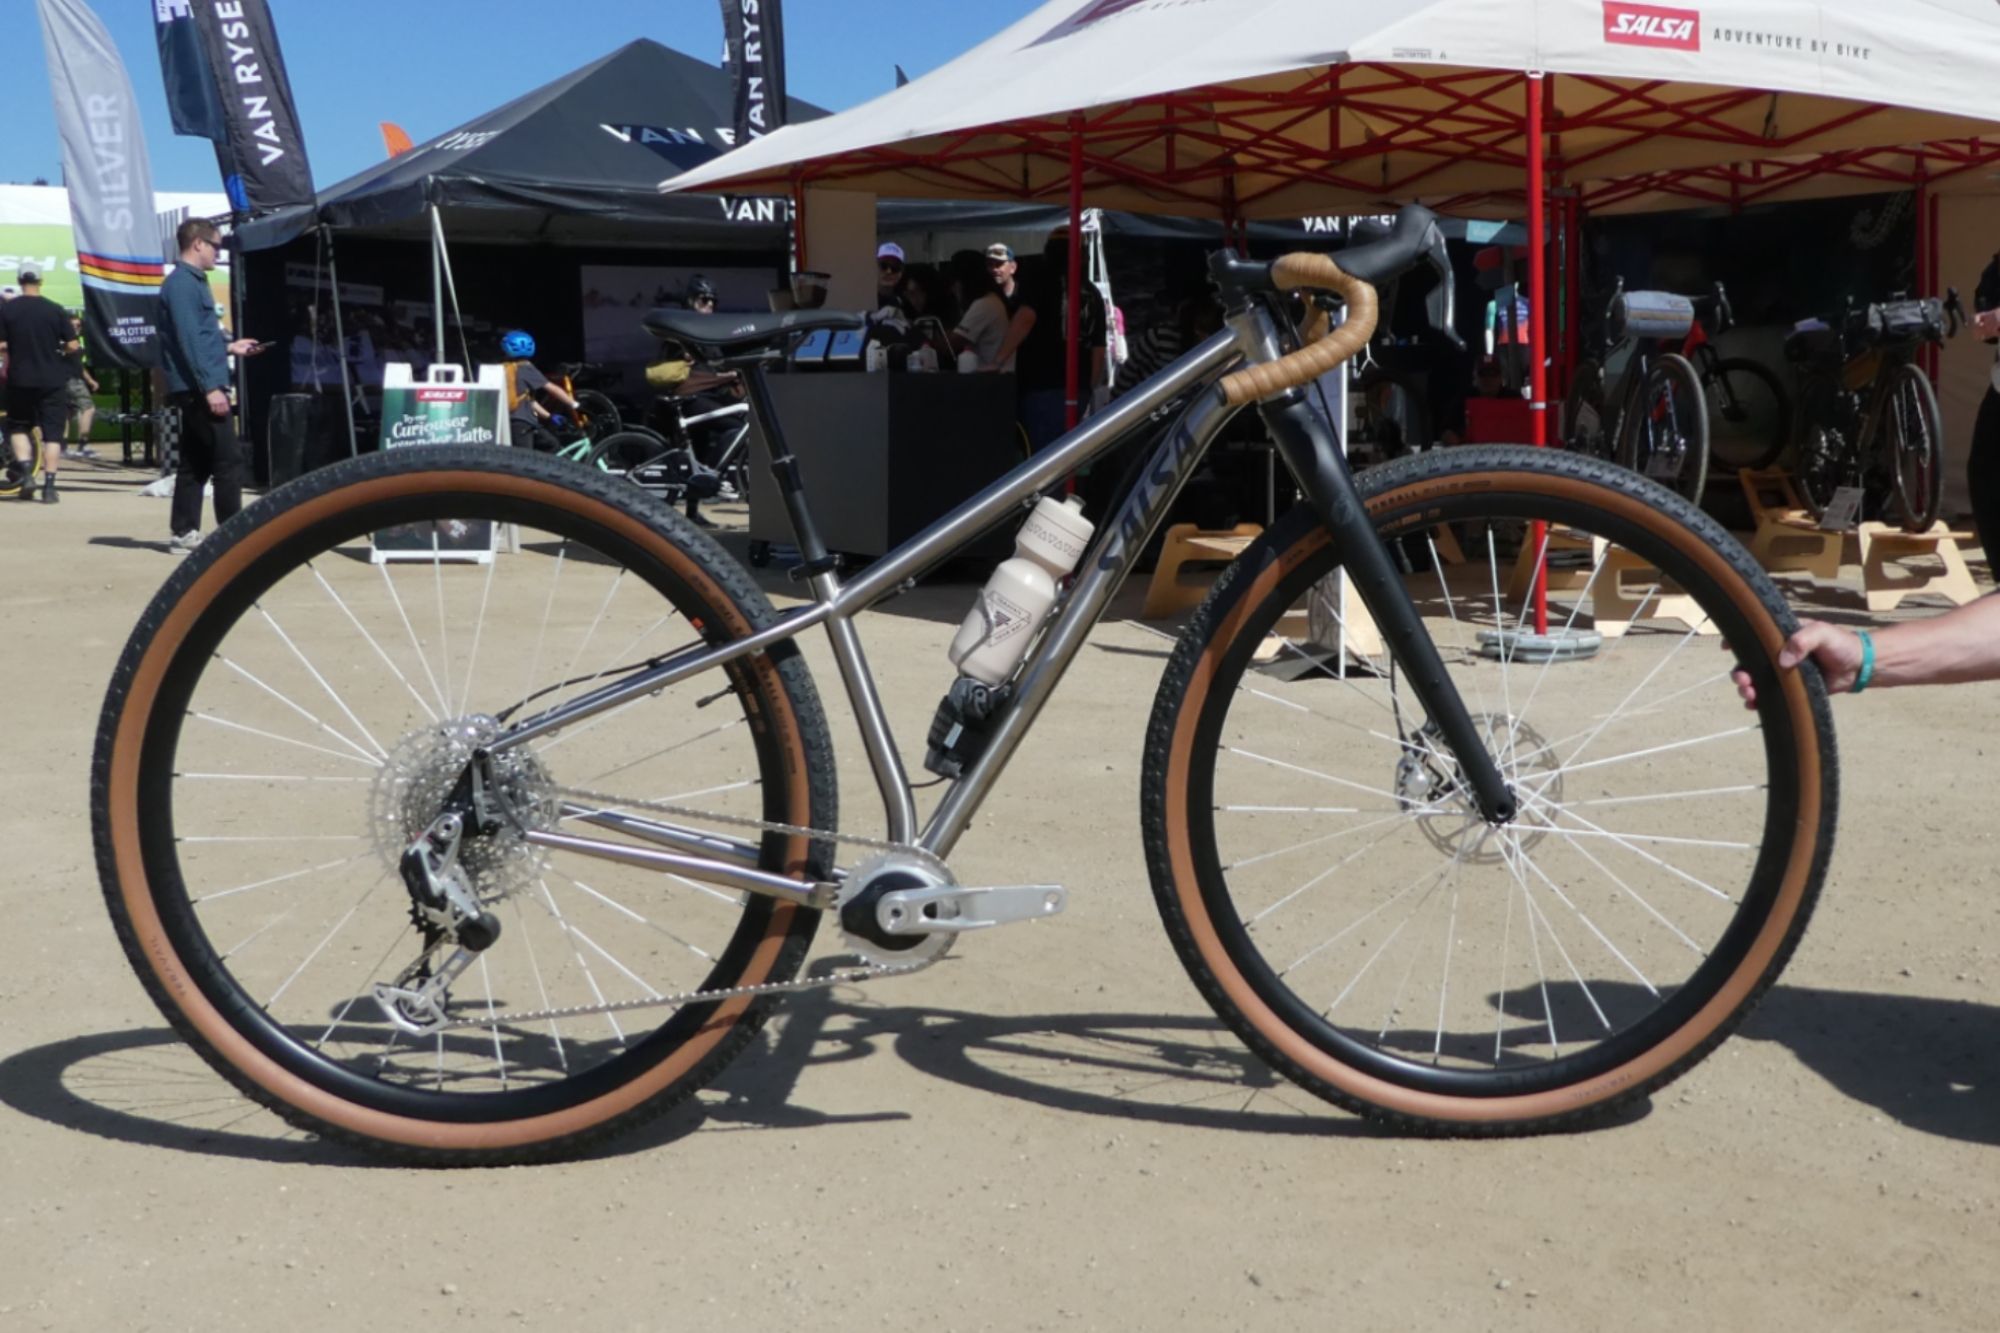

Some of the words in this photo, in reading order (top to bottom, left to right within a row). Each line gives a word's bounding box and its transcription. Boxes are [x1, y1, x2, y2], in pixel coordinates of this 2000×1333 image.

[1608, 13, 1695, 41] SALSA
[1713, 27, 1803, 50] ADVENTURE
[1811, 40, 1828, 53] BY
[1836, 43, 1871, 60] BIKE
[243, 96, 284, 166] VAN
[600, 123, 705, 145] VAN
[86, 94, 134, 232] SILVER
[719, 196, 774, 222] VAN
[1302, 215, 1340, 233] VAN
[392, 415, 469, 439] Curiouser
[1098, 418, 1199, 574] SALSA
